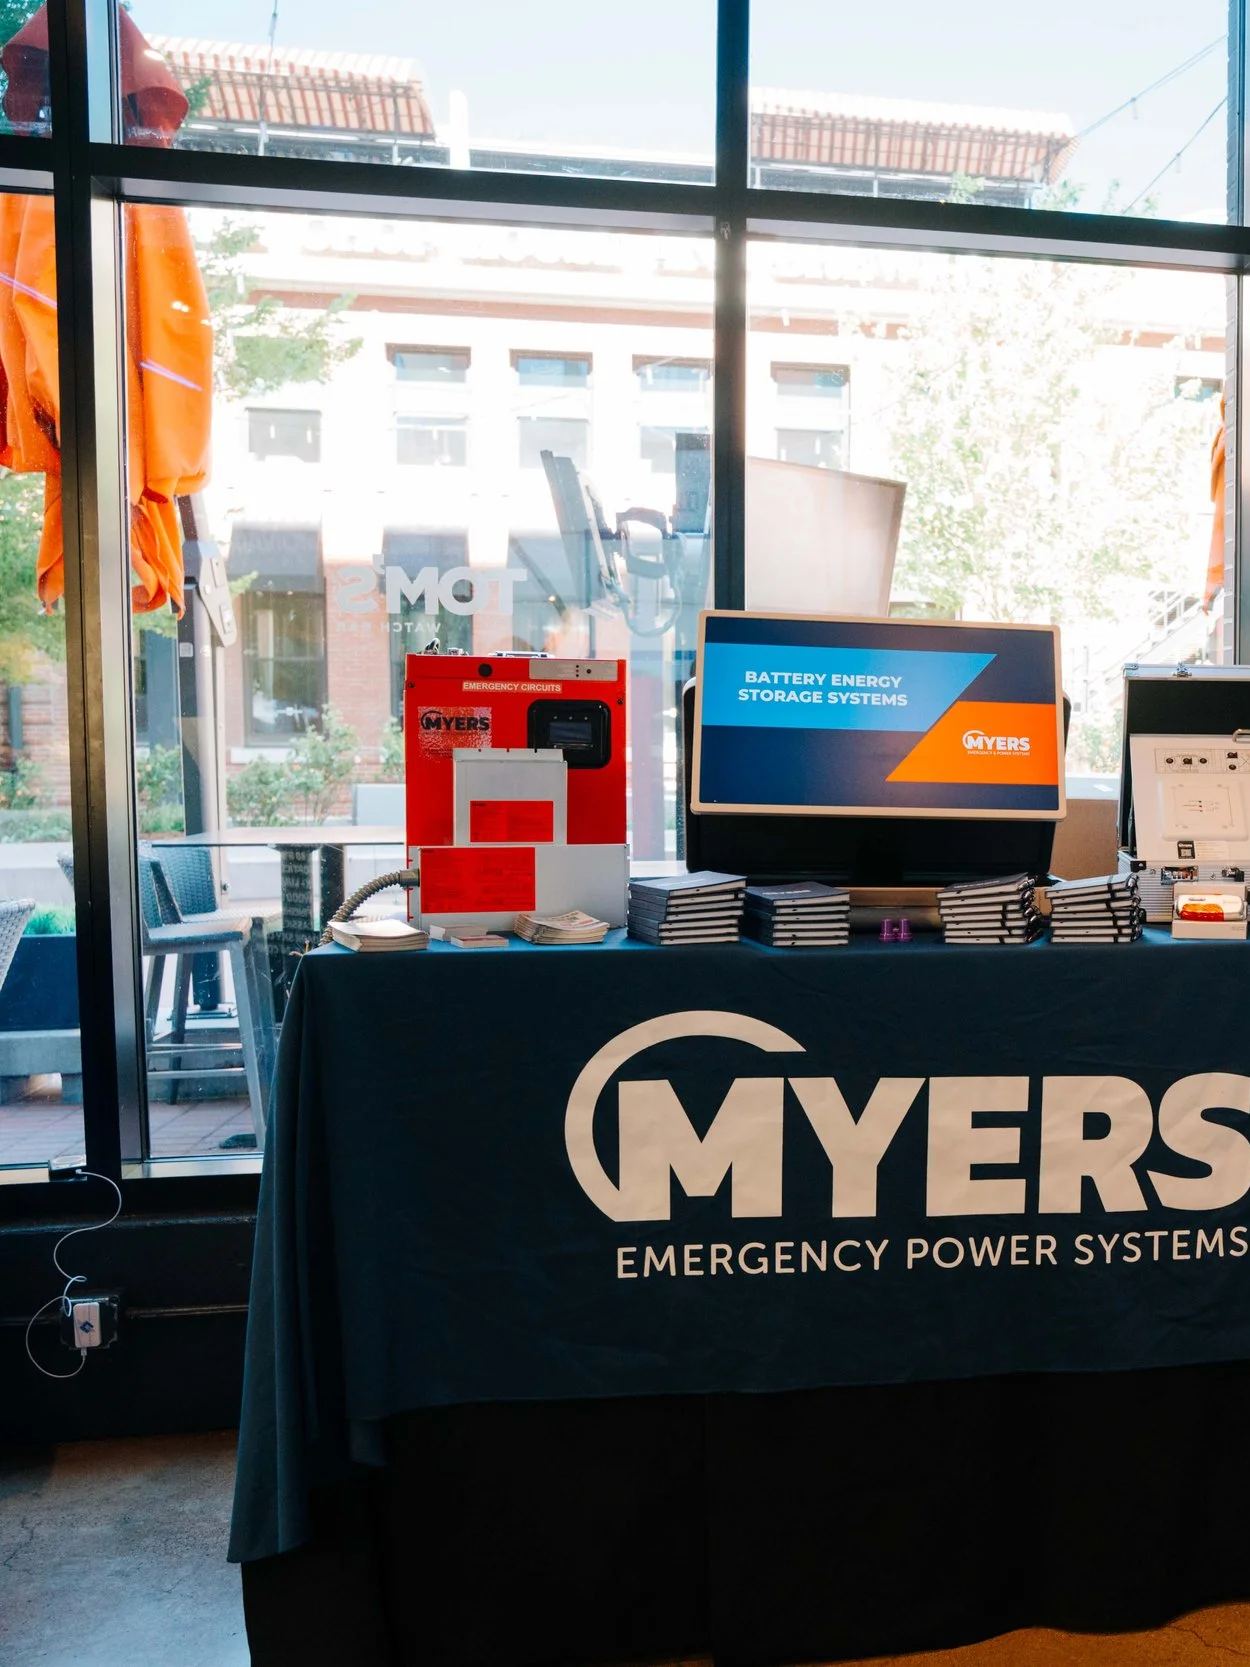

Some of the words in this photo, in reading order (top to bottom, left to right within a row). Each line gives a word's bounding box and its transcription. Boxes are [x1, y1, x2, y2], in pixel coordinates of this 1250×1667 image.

[463, 681, 519, 691] EMERGENCY
[521, 683, 561, 692] CIRCUITS
[745, 670, 826, 687] BATTERY
[831, 673, 902, 689] ENERGY
[738, 688, 823, 704] STORAGE
[827, 691, 908, 707] SYSTEMS
[423, 715, 490, 731] MYERS
[966, 735, 1030, 751] MYERS
[617, 1239, 889, 1279] EMERGENCY
[906, 1233, 1059, 1270] POWER
[1074, 1226, 1249, 1265] SYSTEMS
